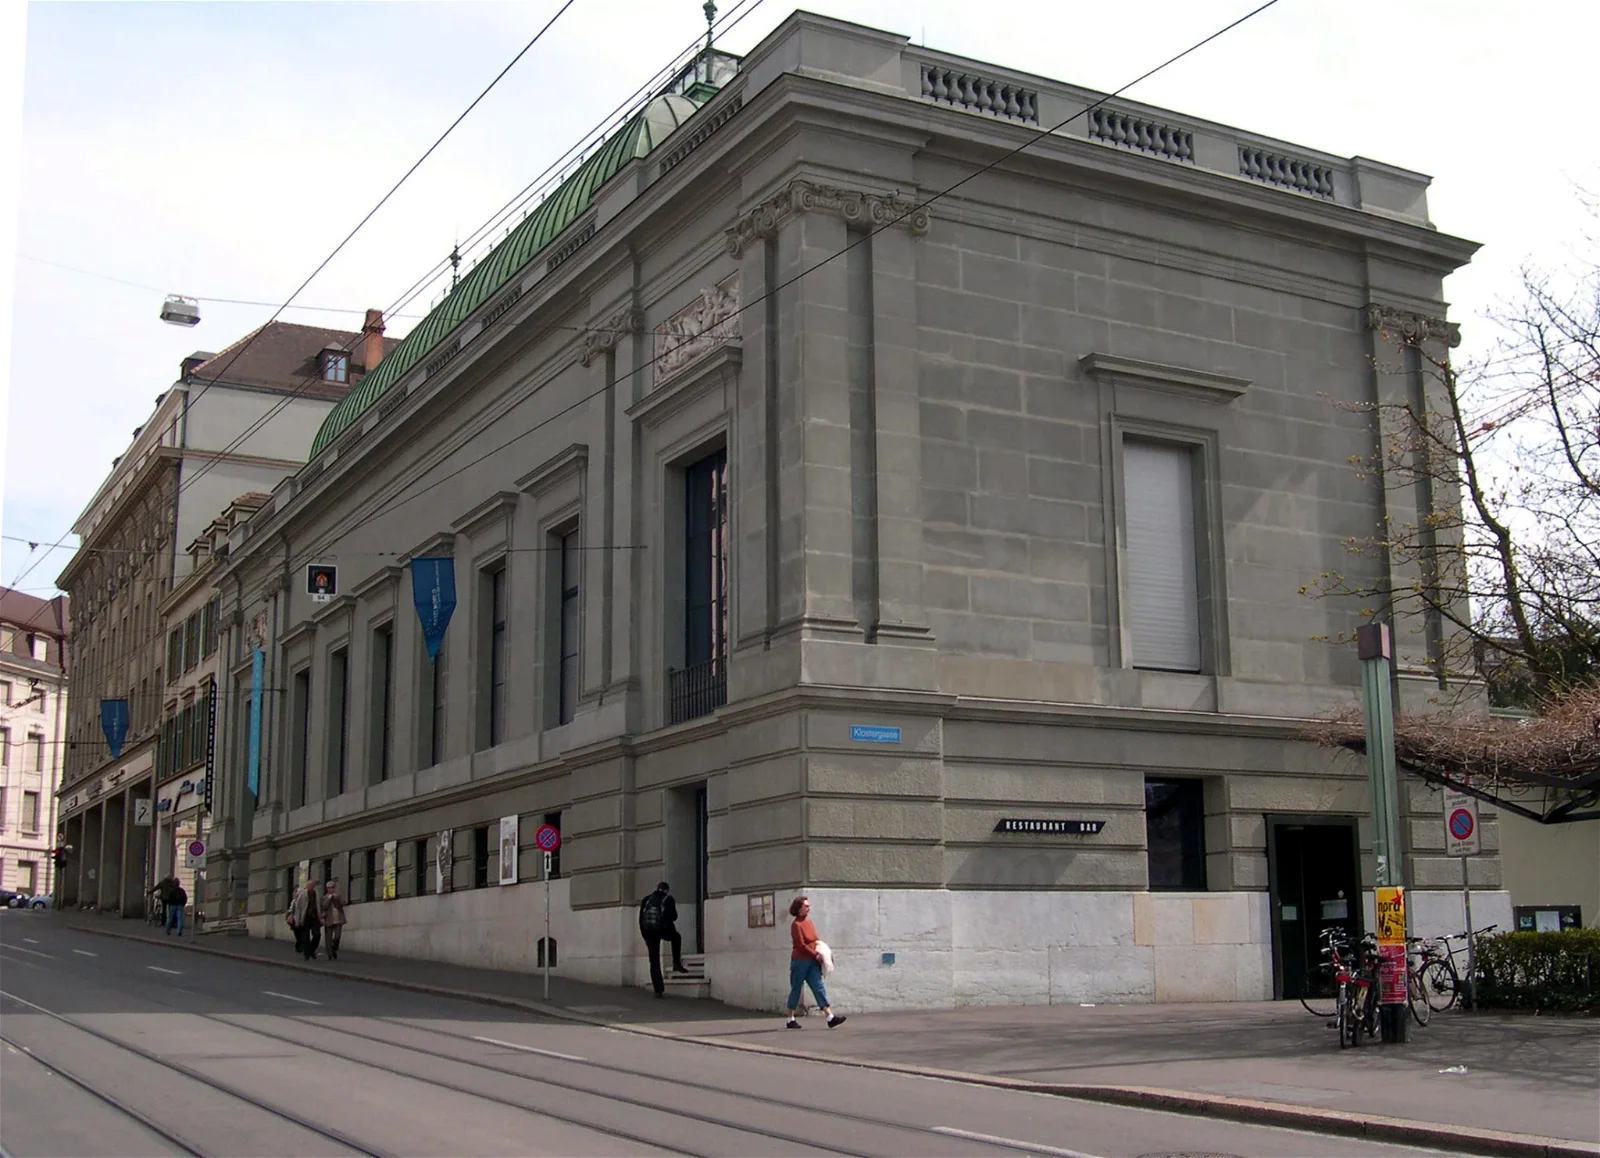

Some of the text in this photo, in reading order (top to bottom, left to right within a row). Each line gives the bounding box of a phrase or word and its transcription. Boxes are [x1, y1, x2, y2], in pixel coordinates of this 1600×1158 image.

[853, 727, 898, 740] Klostergasse
[1005, 821, 1098, 832] RESTAURANT BAR
